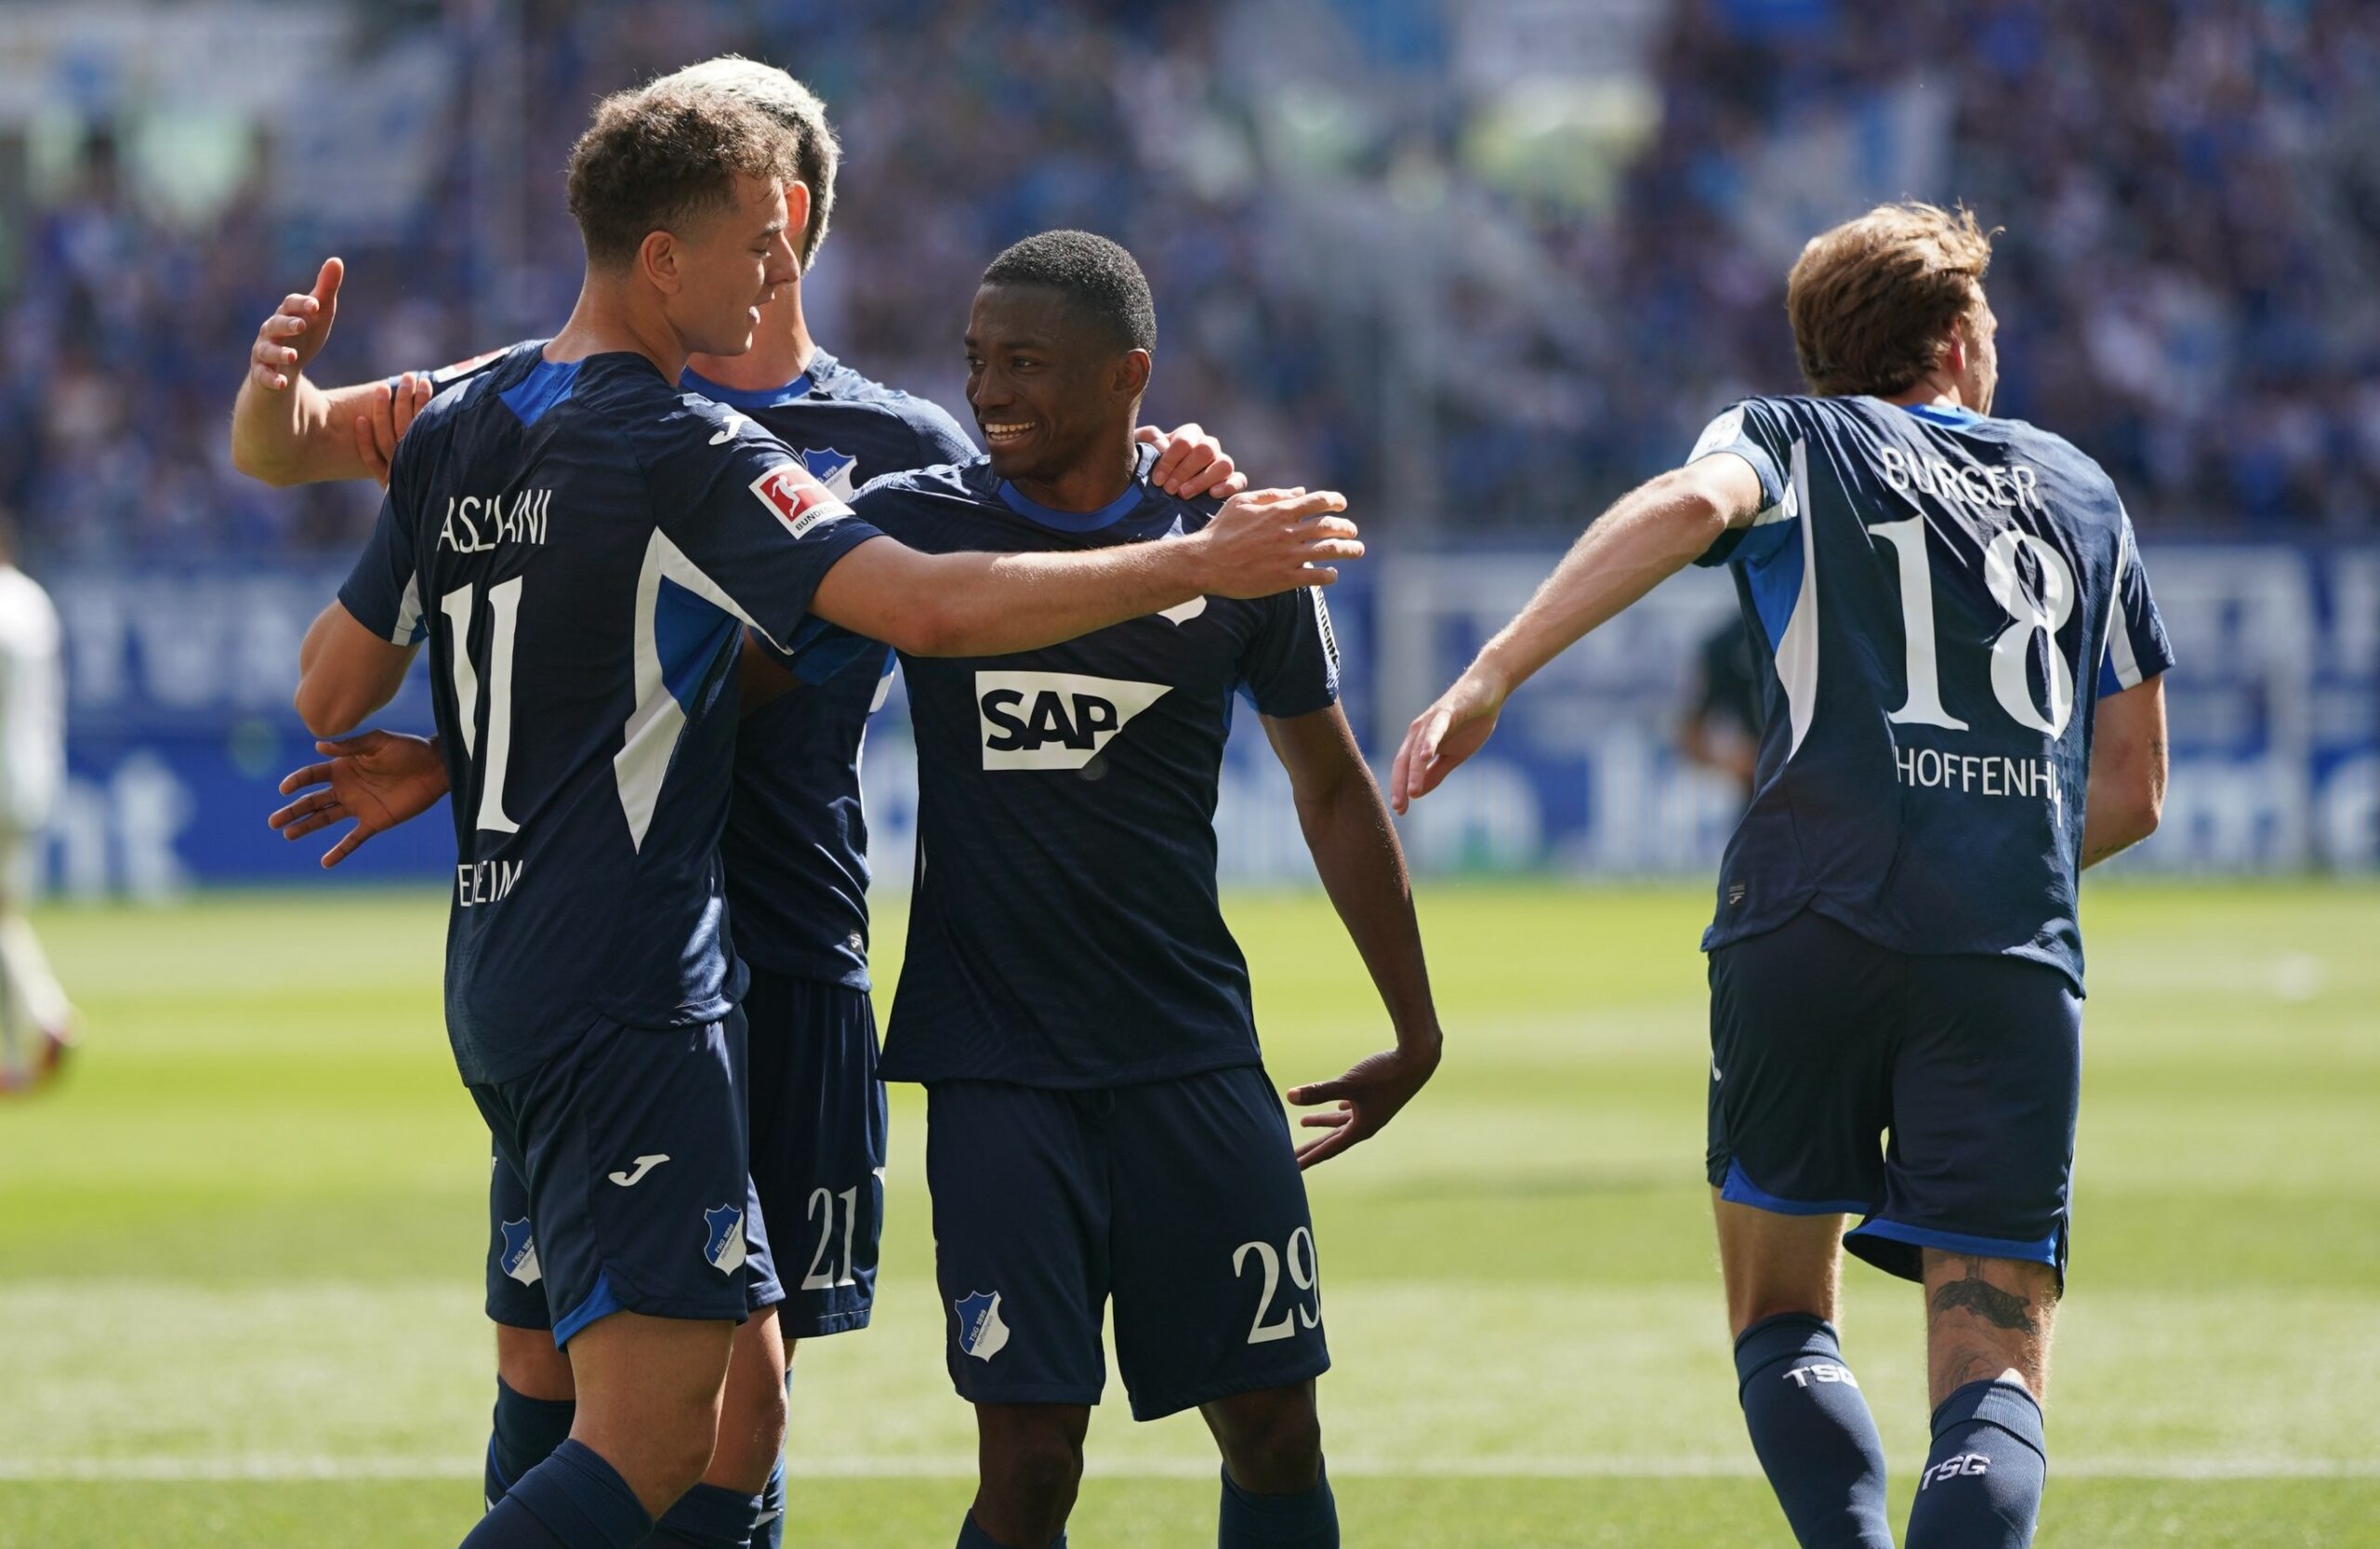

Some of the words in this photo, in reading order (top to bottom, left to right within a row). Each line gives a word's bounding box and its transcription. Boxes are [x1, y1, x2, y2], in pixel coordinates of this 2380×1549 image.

[1881, 446, 2042, 510] BURGER
[1868, 513, 2074, 742] 18
[981, 688, 1118, 751] SAP
[800, 1185, 857, 1291] 21
[1233, 1226, 1320, 1344] 29
[1922, 1453, 1990, 1490] TSG
